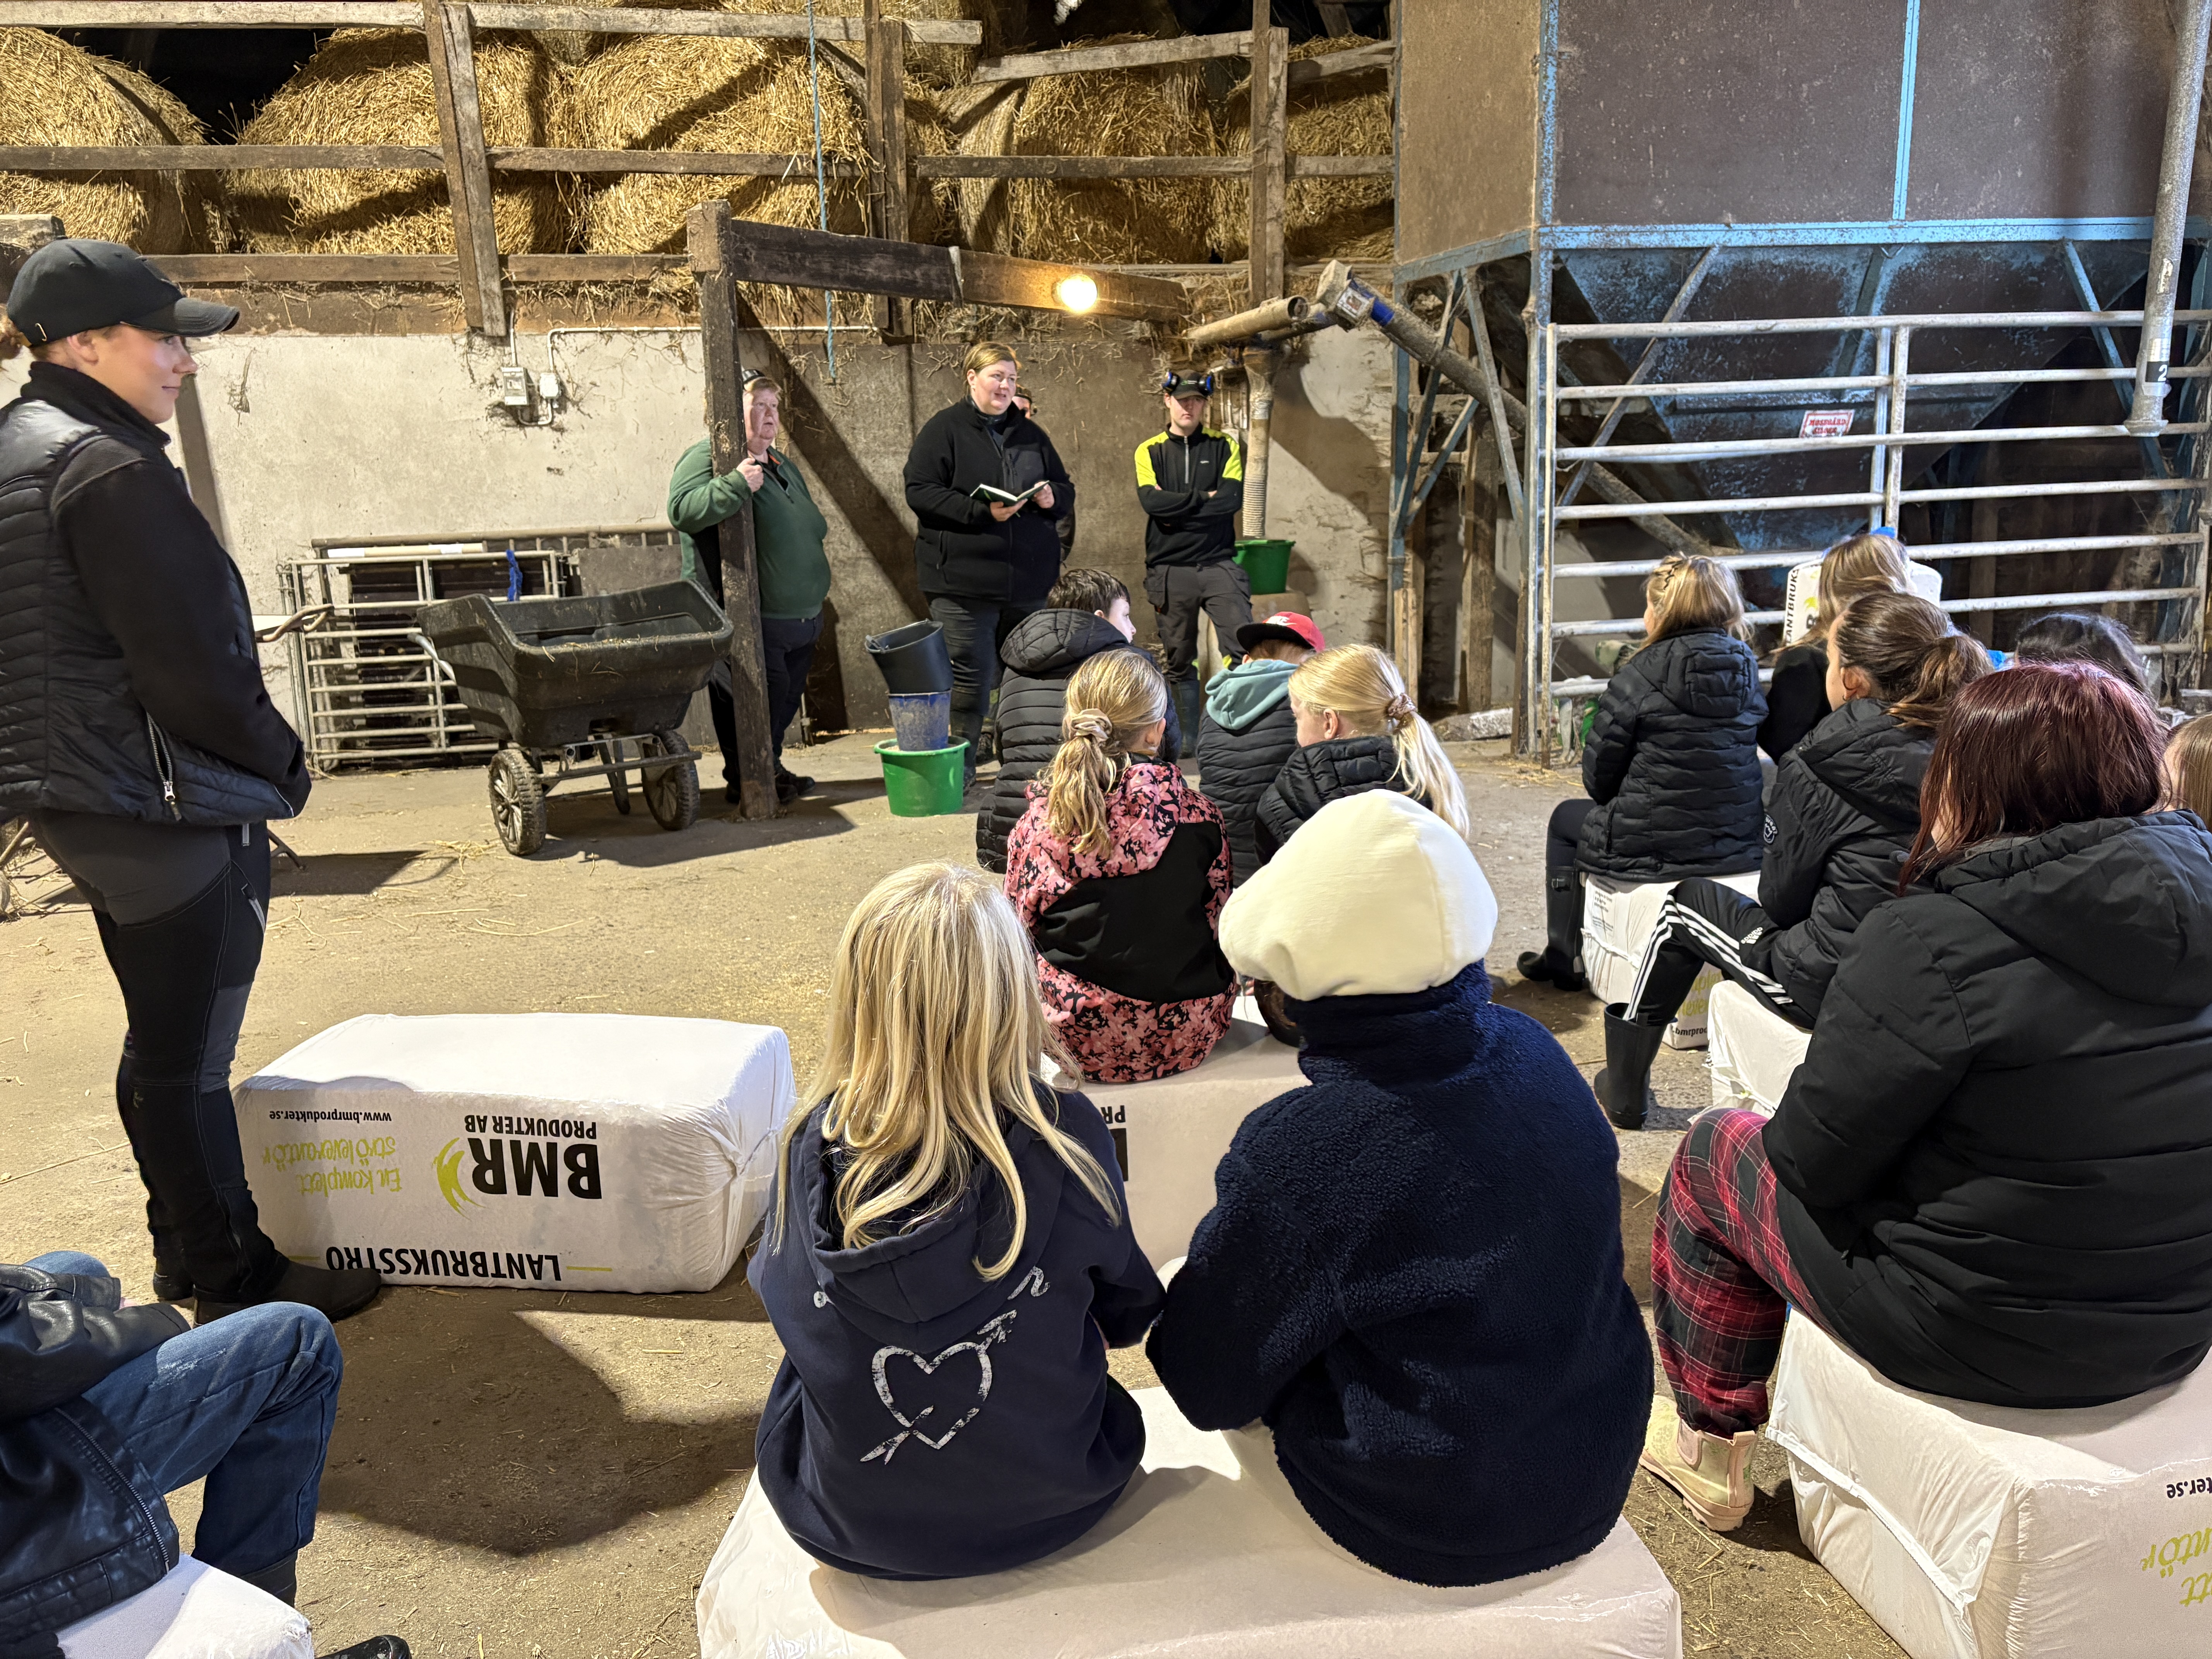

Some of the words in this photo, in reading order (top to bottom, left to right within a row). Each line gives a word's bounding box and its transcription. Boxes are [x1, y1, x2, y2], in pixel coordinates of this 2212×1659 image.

[2158, 364, 2168, 381] 2
[269, 1109, 392, 1123] www.bmrprodukter.se
[464, 1115, 488, 1133] AB
[491, 1115, 597, 1139] PRODUKTER
[376, 1168, 402, 1192] En
[467, 1138, 602, 1199] BMR
[295, 1166, 374, 1197] komplett
